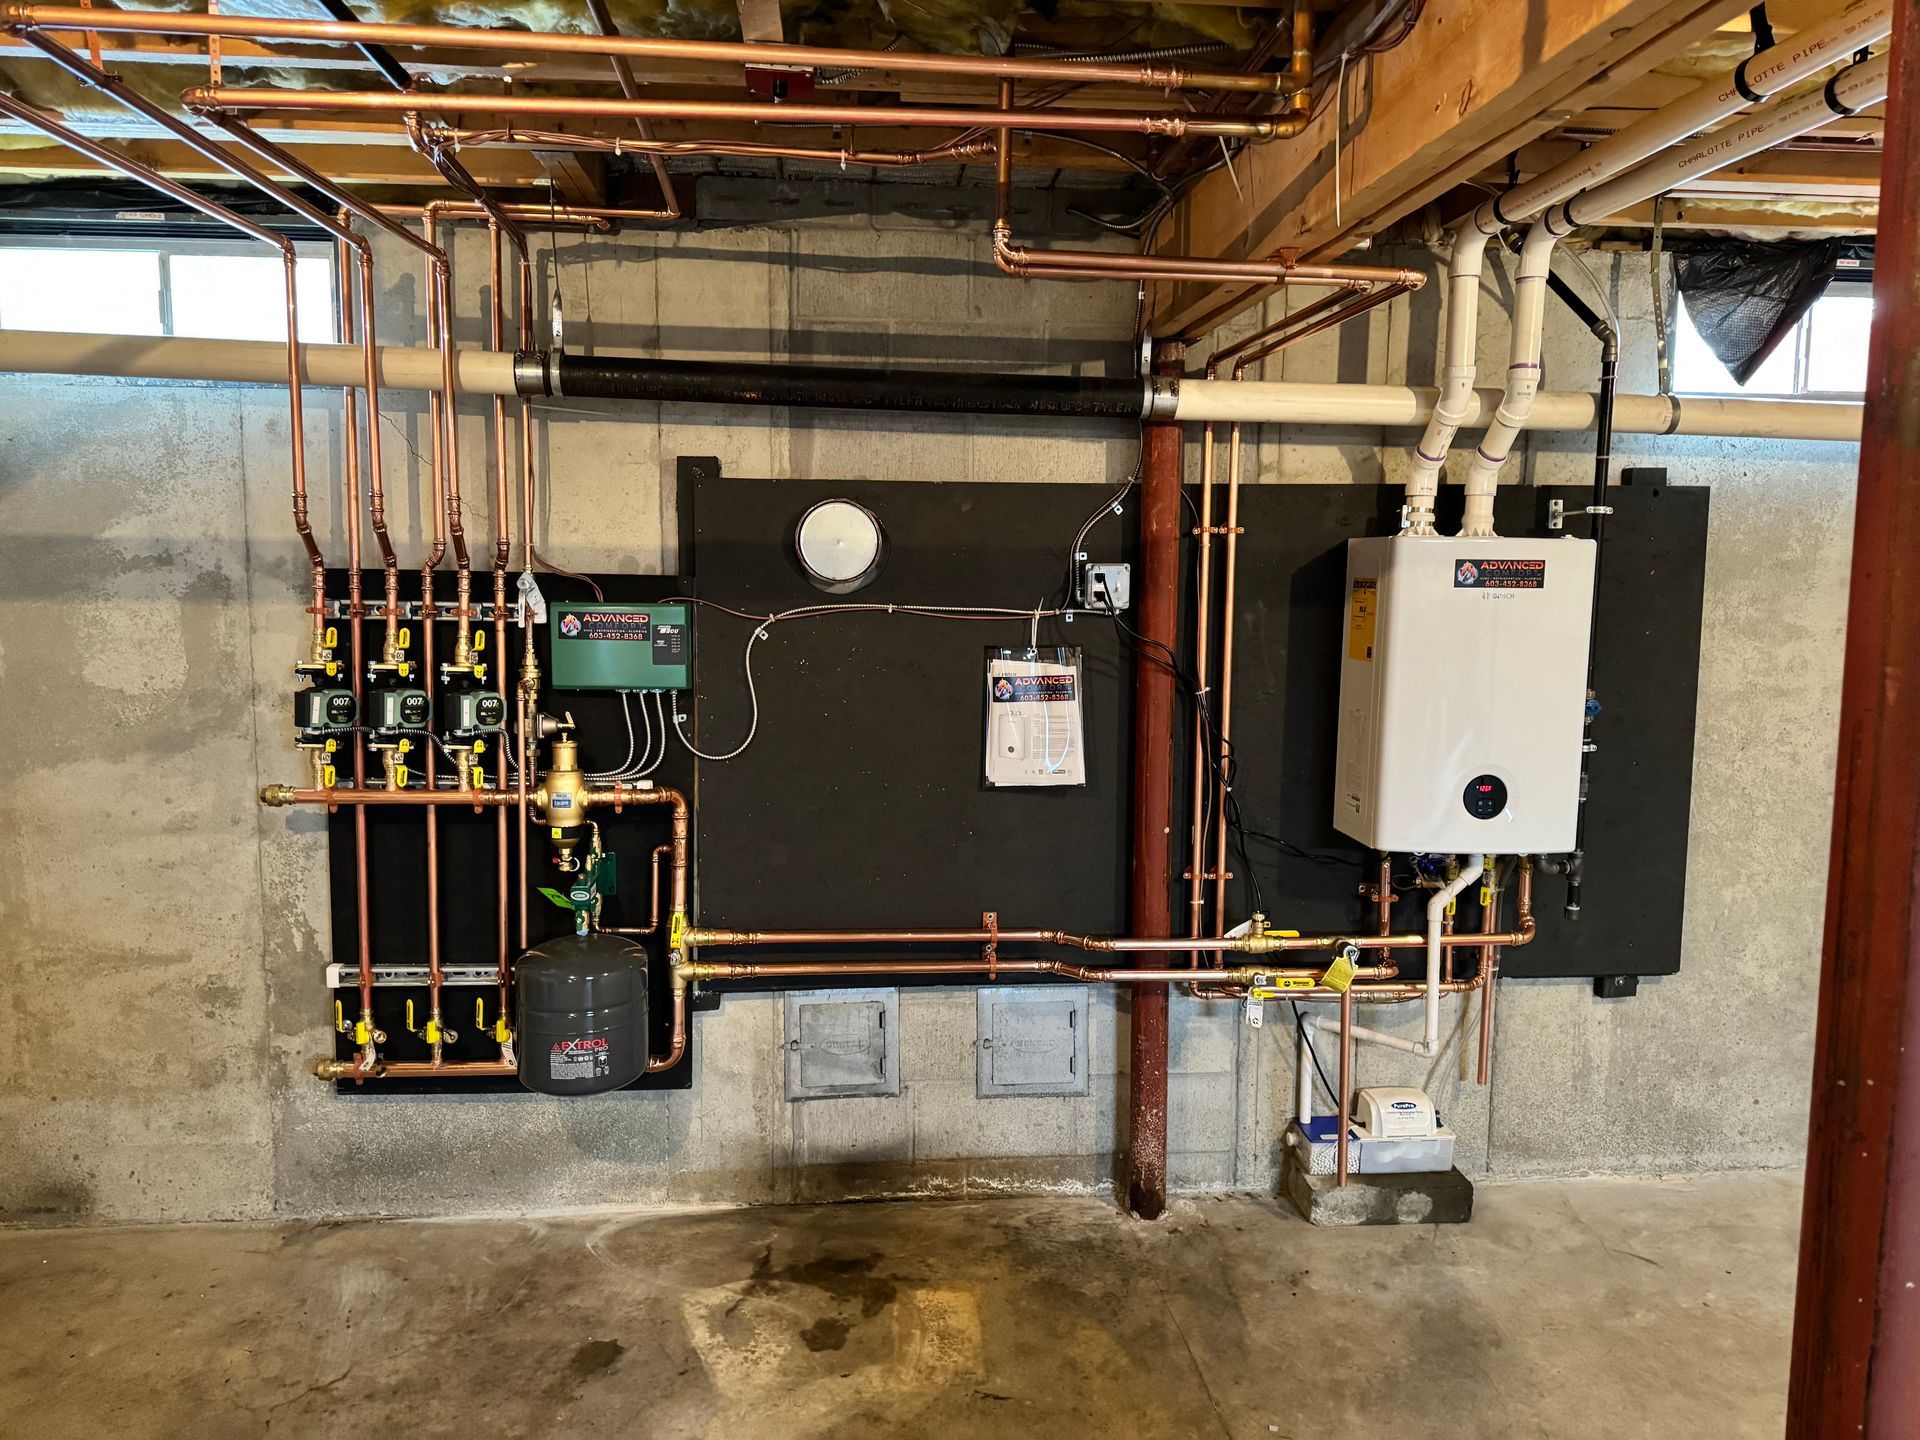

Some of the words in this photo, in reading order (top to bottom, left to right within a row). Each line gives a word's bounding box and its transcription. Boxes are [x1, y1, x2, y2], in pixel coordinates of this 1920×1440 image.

[1718, 60, 1786, 103] CHALOTTE
[1792, 38, 1827, 63] PIPE
[1678, 139, 1733, 169] CHARLOTTE
[1737, 124, 1765, 142] PIPE
[1480, 561, 1544, 570] ADVANCED
[1485, 580, 1537, 588] 603-452-8368
[583, 613, 649, 623] ADVANCED
[589, 632, 643, 640] 603-452-8368
[1015, 676, 1074, 686] ADVANCED
[561, 1038, 609, 1055] EXTROL
[594, 1045, 609, 1053] PRO
